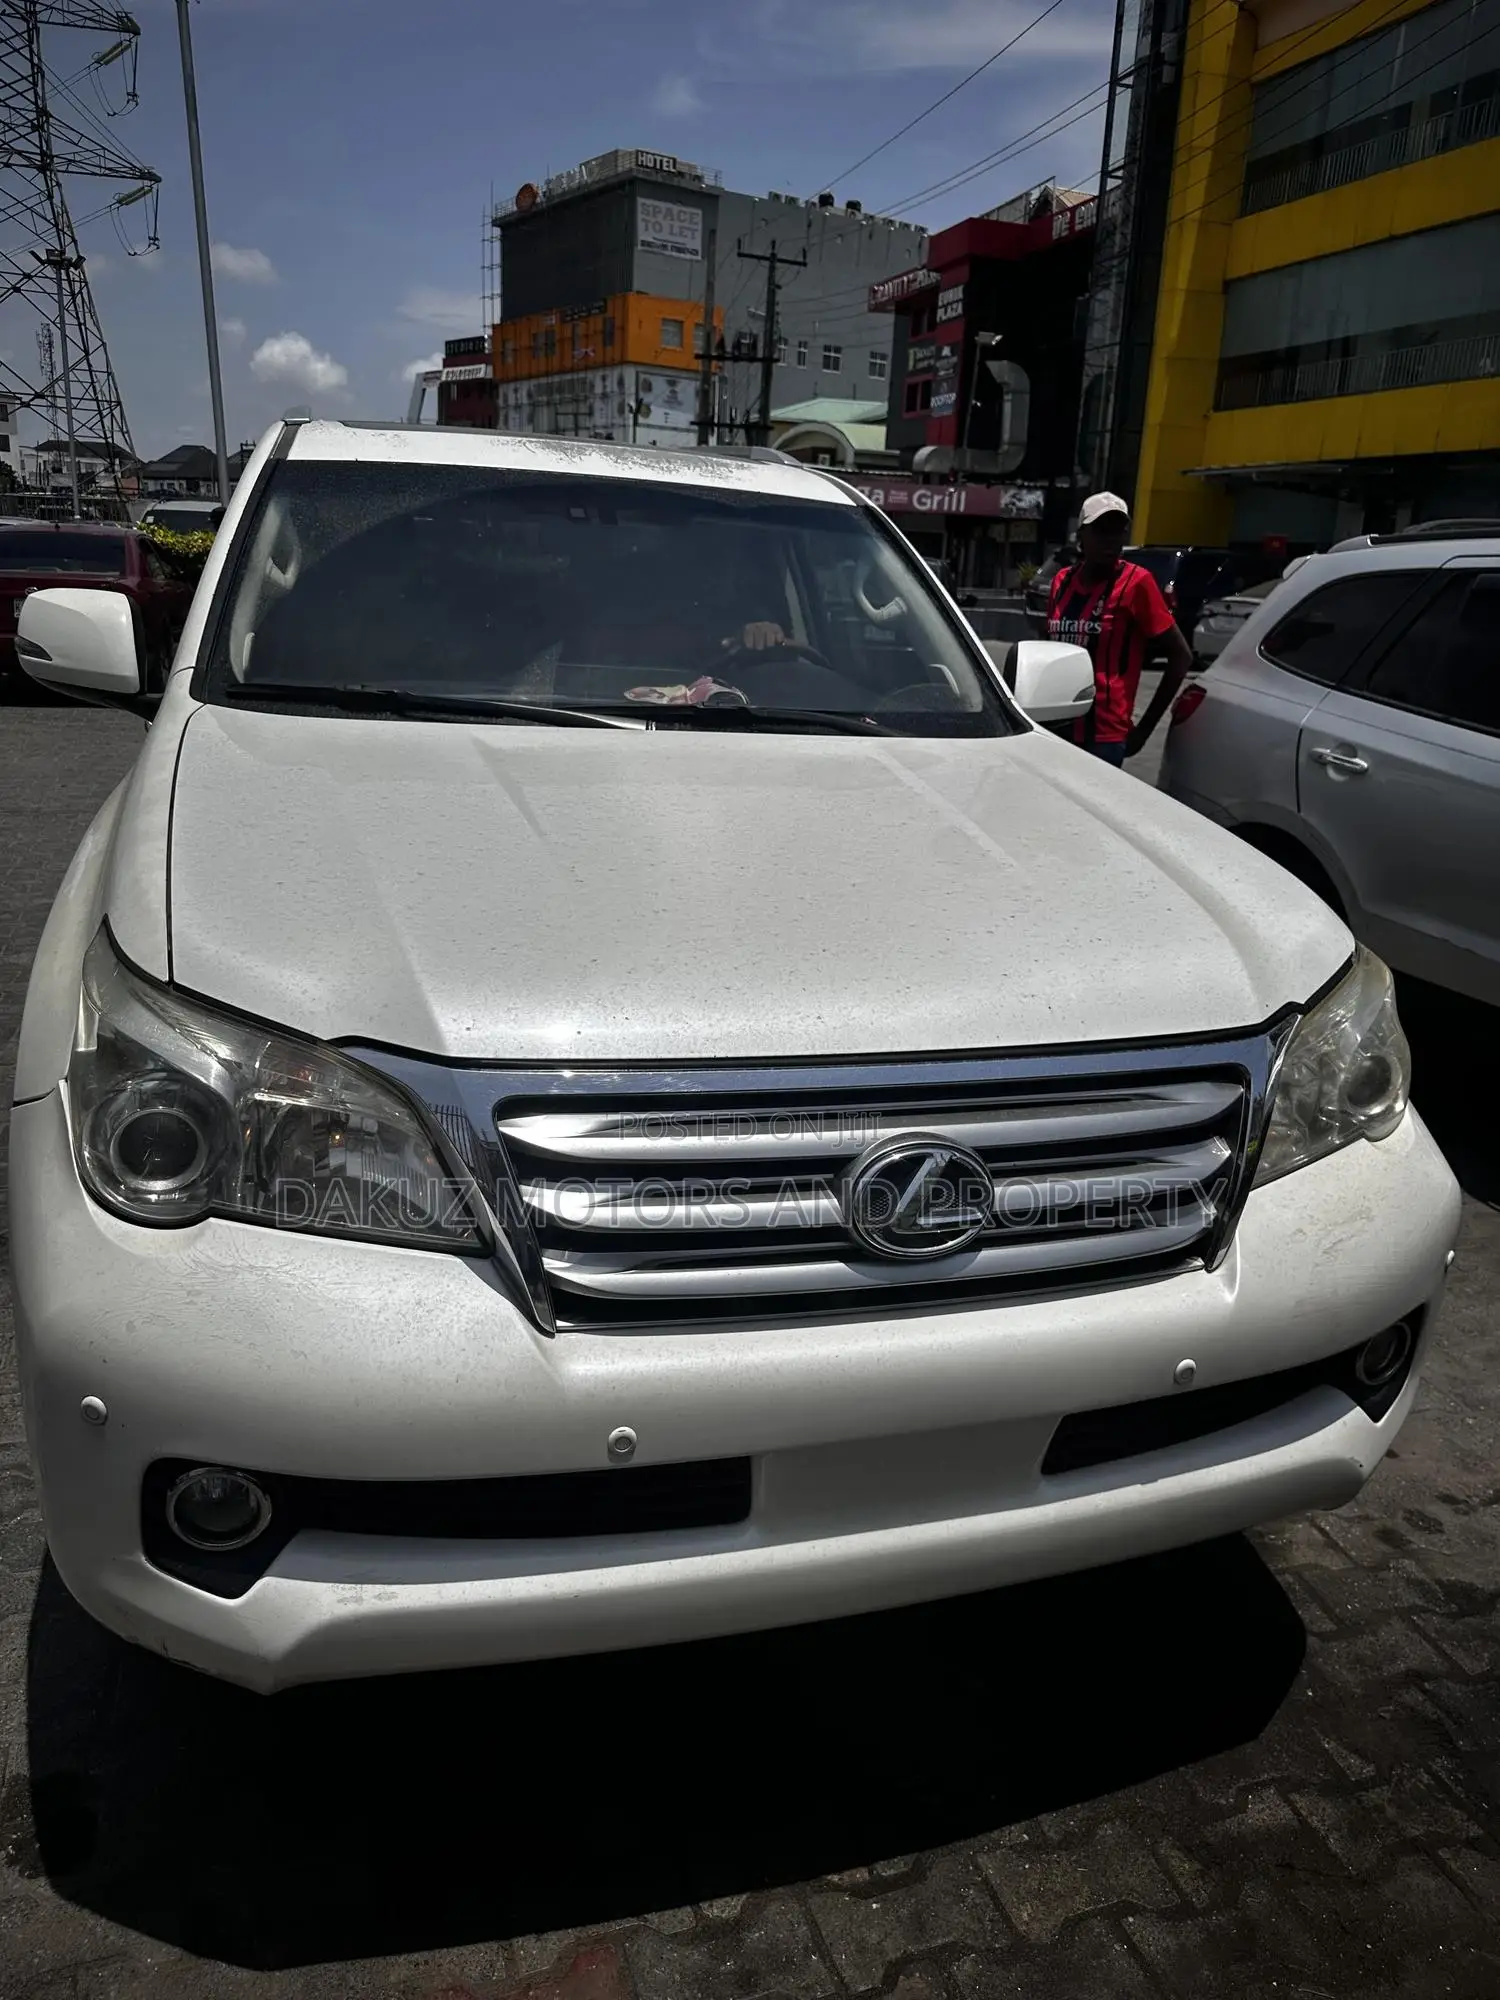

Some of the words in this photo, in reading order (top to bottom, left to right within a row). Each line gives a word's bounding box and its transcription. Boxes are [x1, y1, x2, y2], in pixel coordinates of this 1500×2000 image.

[637, 151, 677, 172] HOTEL
[640, 202, 700, 225] SPACE
[641, 217, 663, 234] TO
[668, 222, 699, 240] LET
[912, 488, 966, 512] Grill
